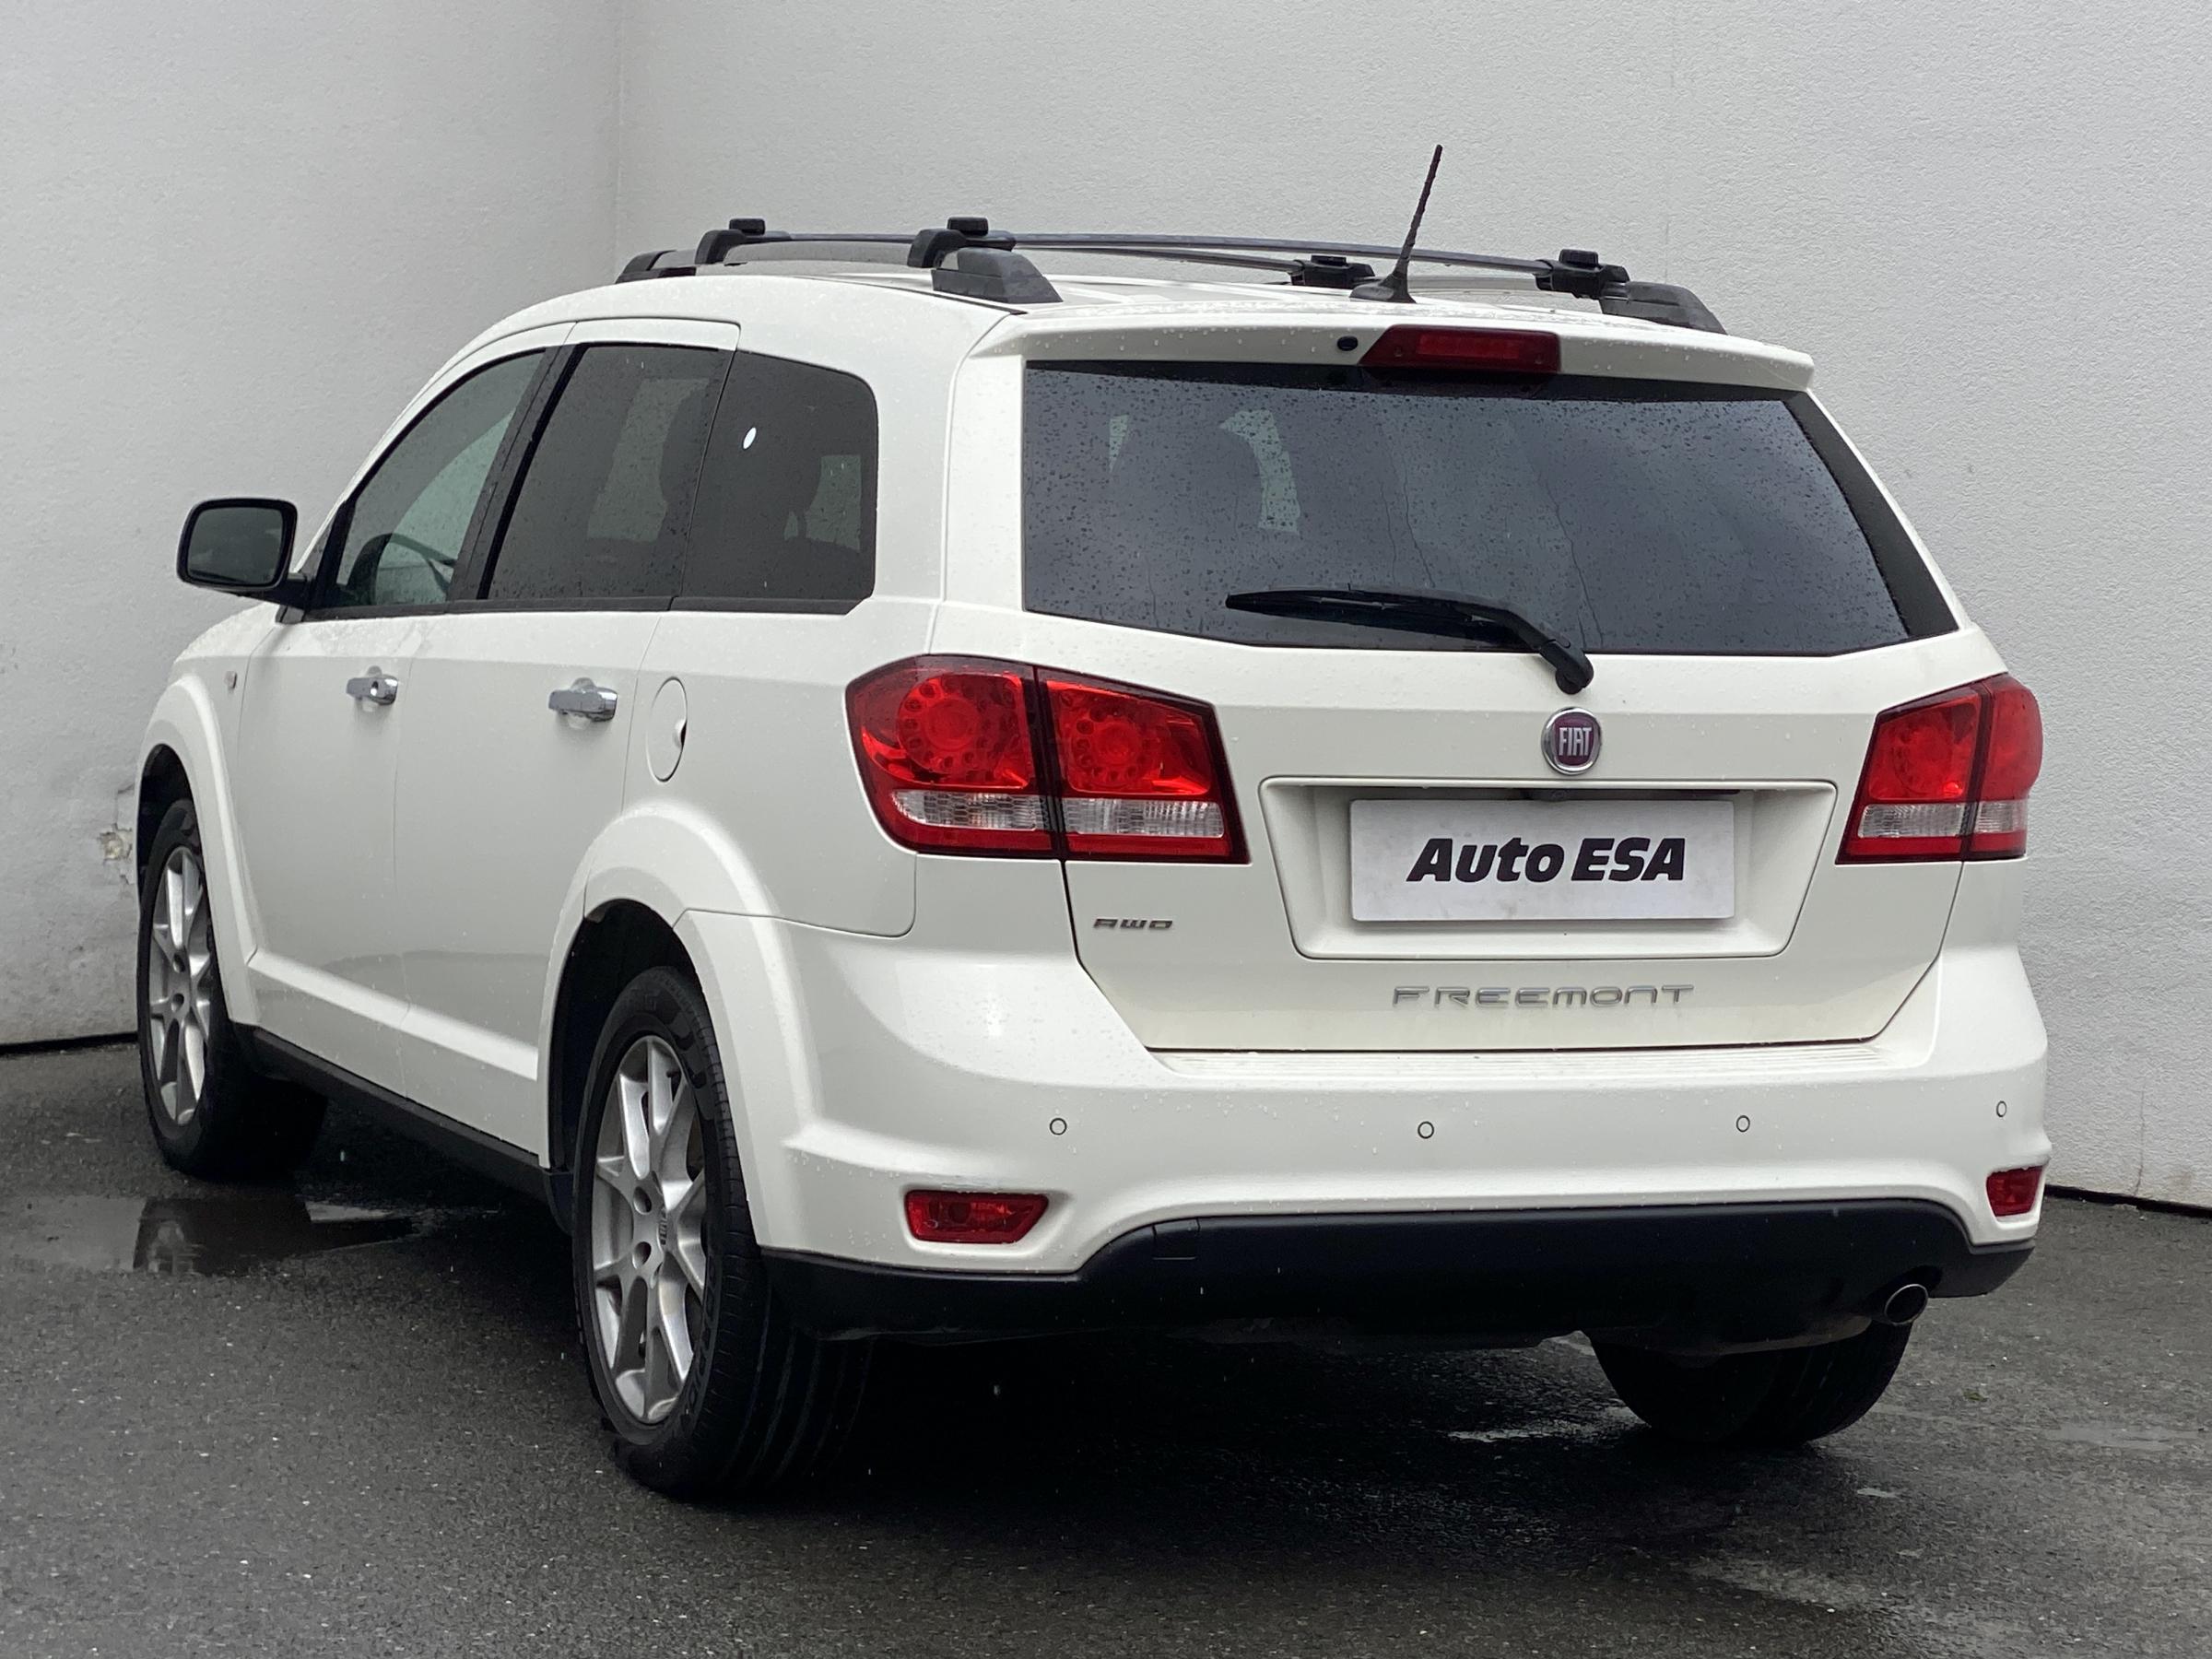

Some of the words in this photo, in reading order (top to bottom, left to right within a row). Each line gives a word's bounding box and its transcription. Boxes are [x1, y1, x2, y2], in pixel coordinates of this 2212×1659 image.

[1559, 726, 1592, 756] FIAT
[1406, 837, 1565, 883] Auto
[1571, 837, 1686, 882] ESA
[1093, 917, 1173, 929] AWD
[1393, 984, 1694, 1007] FREEMONT
